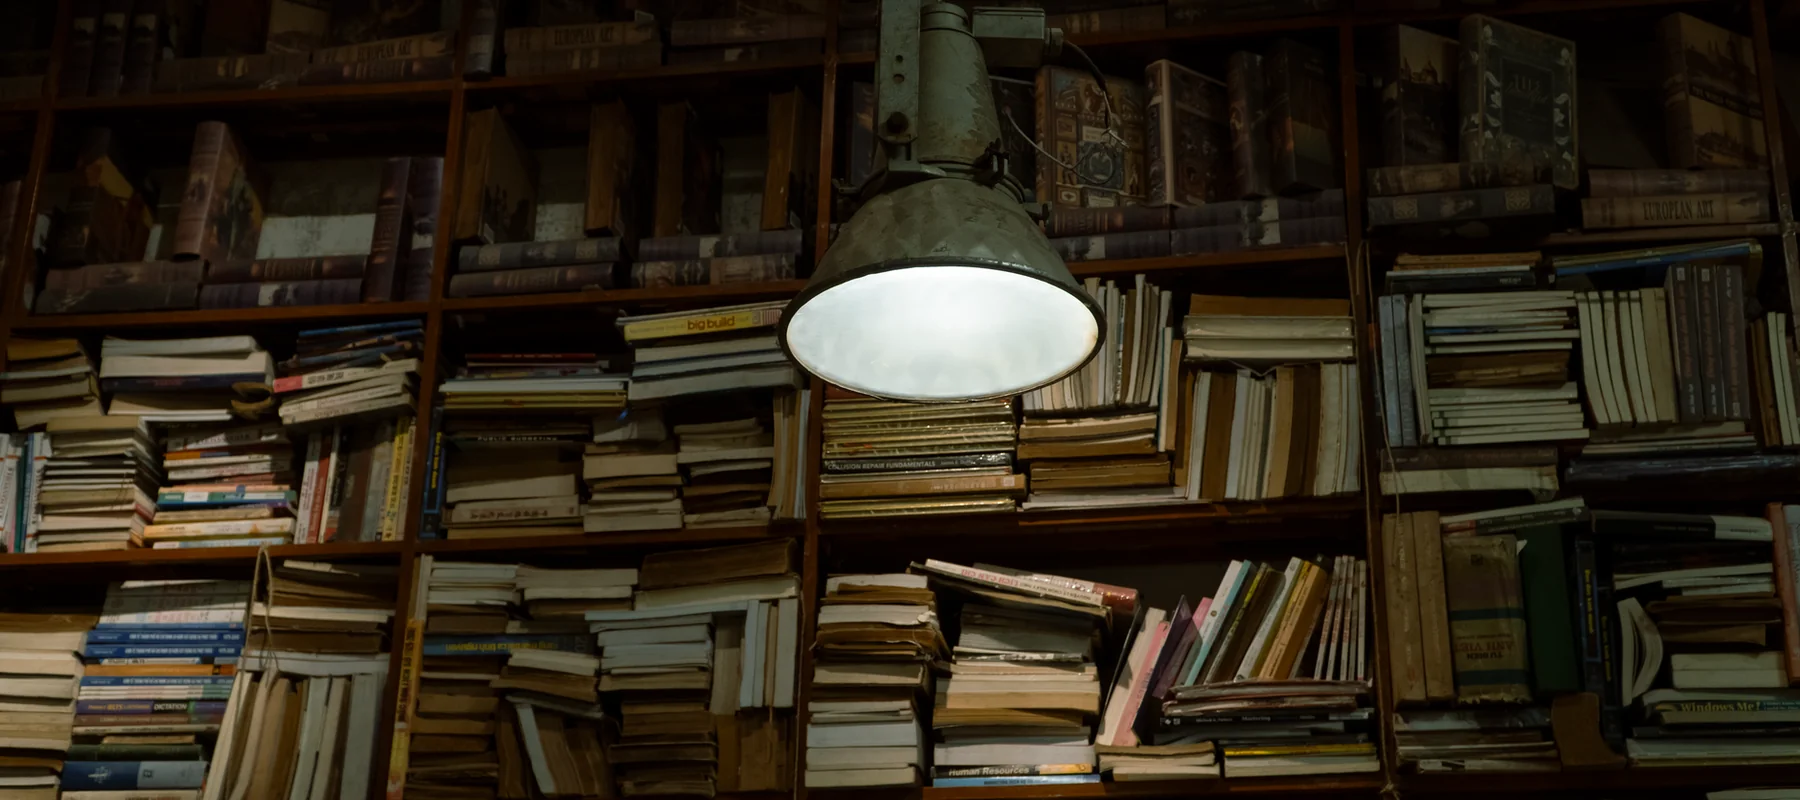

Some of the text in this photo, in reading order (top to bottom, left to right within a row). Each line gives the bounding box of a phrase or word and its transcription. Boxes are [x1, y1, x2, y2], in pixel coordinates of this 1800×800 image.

[554, 25, 614, 46] EUROPEAN ART
[1642, 199, 1714, 221] EUROPEAN ART
[687, 315, 736, 331] big build
[828, 462, 861, 471] COLLISION
[862, 462, 885, 470] REPAIR
[886, 460, 936, 470] FUNDAMENTALS
[153, 703, 188, 711] DICTATION
[1681, 701, 1735, 712] Windows
[948, 765, 1030, 777] Human Resources
